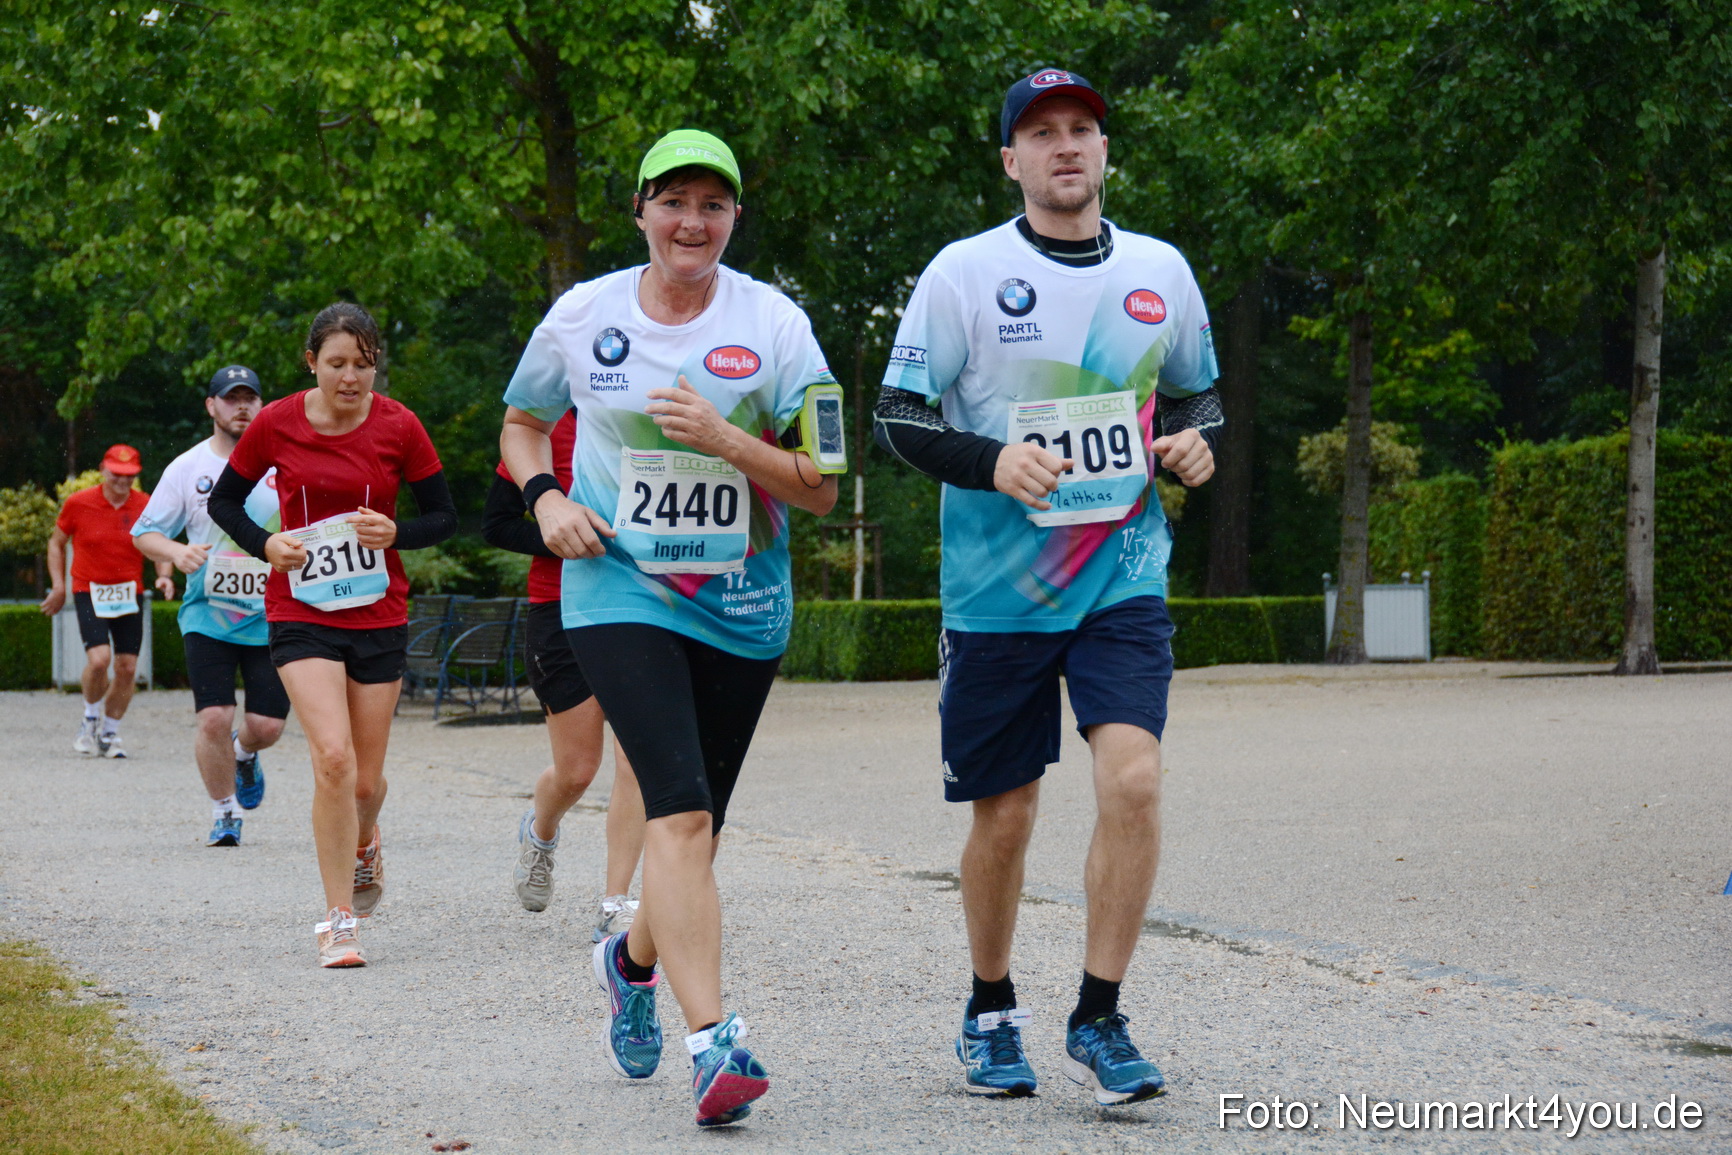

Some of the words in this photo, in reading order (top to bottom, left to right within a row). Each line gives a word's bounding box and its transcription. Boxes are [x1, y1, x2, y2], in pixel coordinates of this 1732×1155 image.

[1130, 297, 1164, 315] Hervis
[998, 322, 1042, 335] PARTL
[1000, 334, 1042, 344] Neumarkt
[712, 354, 755, 370] Hervis
[890, 345, 927, 364] BOCK
[590, 372, 629, 383] PARTL
[1066, 397, 1126, 417] BOCK
[1016, 414, 1059, 424] NeuerMarkt
[674, 456, 737, 475] BOCK
[631, 480, 738, 527] 2440
[620, 519, 626, 527] D
[654, 541, 705, 560] Ingrid
[301, 541, 376, 582] 2310
[213, 571, 268, 595] 2303
[723, 570, 751, 589] 17.
[96, 586, 130, 601] 2251
[333, 582, 352, 597] Evi
[722, 584, 782, 602] Neumarkter
[723, 599, 774, 616] Stadtlauf
